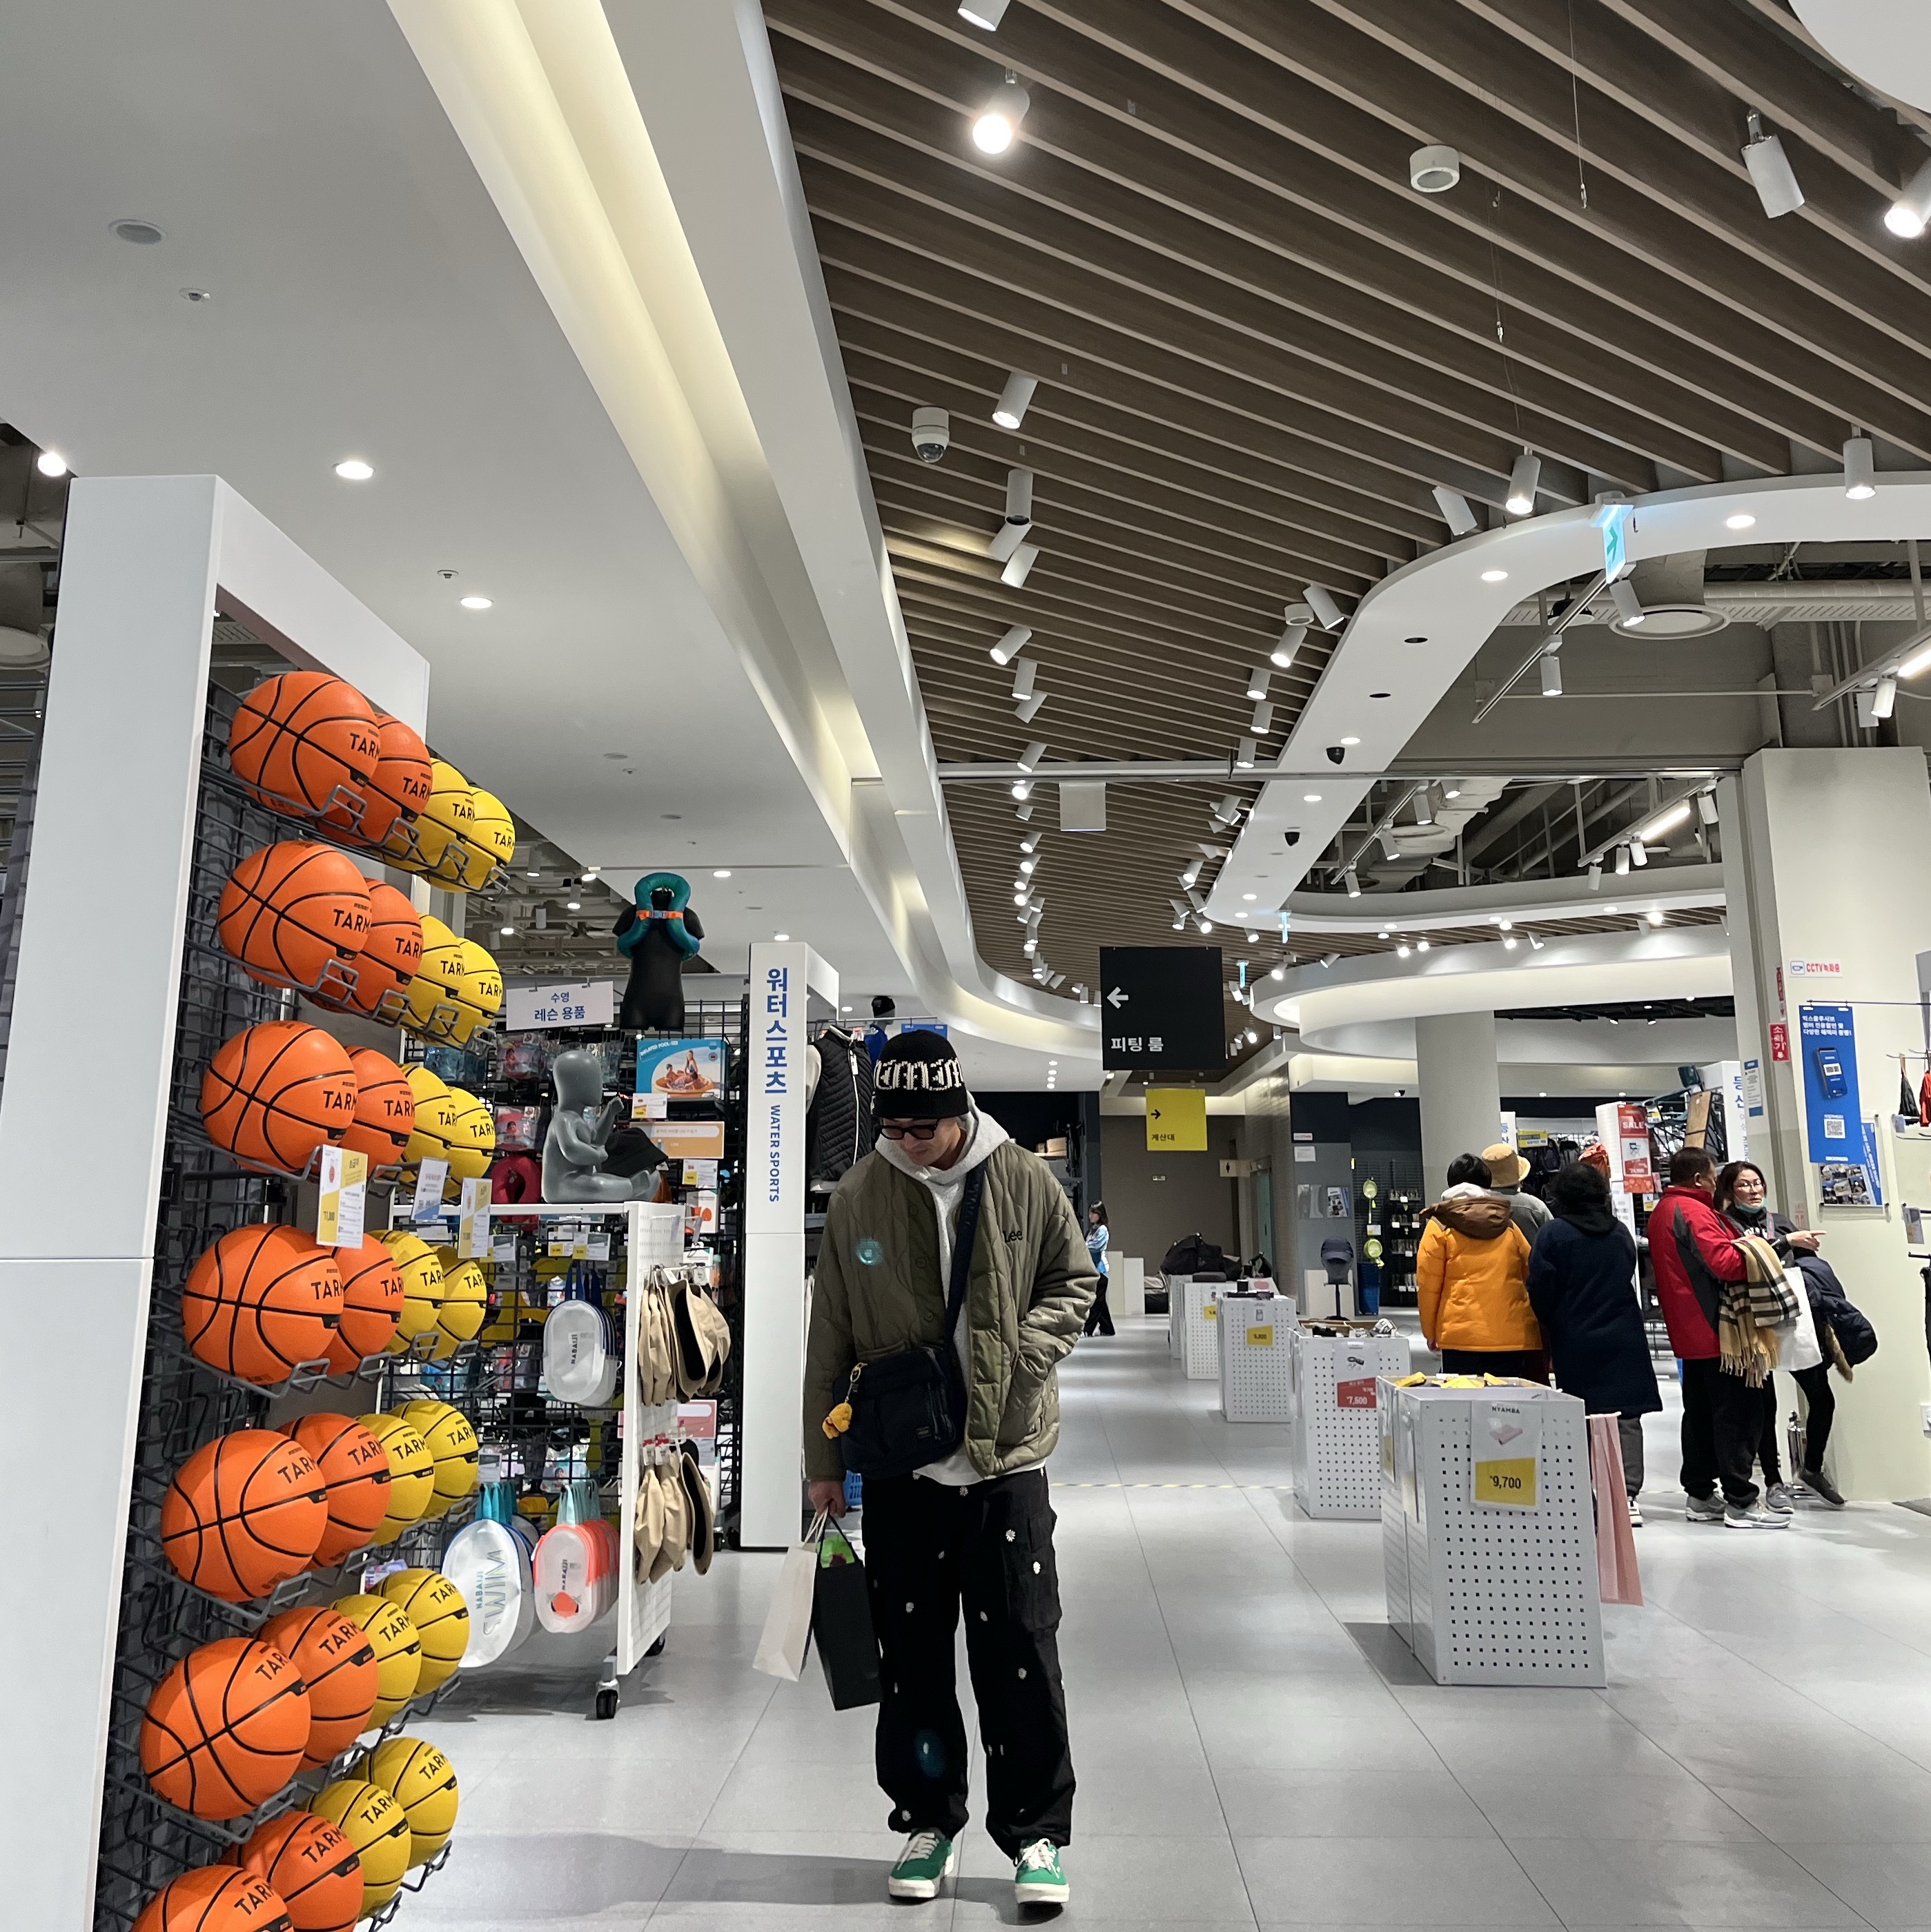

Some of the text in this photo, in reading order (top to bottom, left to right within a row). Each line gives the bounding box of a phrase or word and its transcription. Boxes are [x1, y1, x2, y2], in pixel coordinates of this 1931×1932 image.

[551, 992, 569, 1003] 수영
[534, 1005, 585, 1022] 레슨 용품
[765, 968, 787, 1094] 워터스포츠
[1772, 1026, 1787, 1051] 소화기
[1110, 1037, 1164, 1052] 피팅 룸
[1623, 1121, 1645, 1129] SALE
[769, 1104, 781, 1202] WATER SPORTS
[1003, 1231, 1023, 1242] Lee
[1491, 1406, 1520, 1414] NYAMBA
